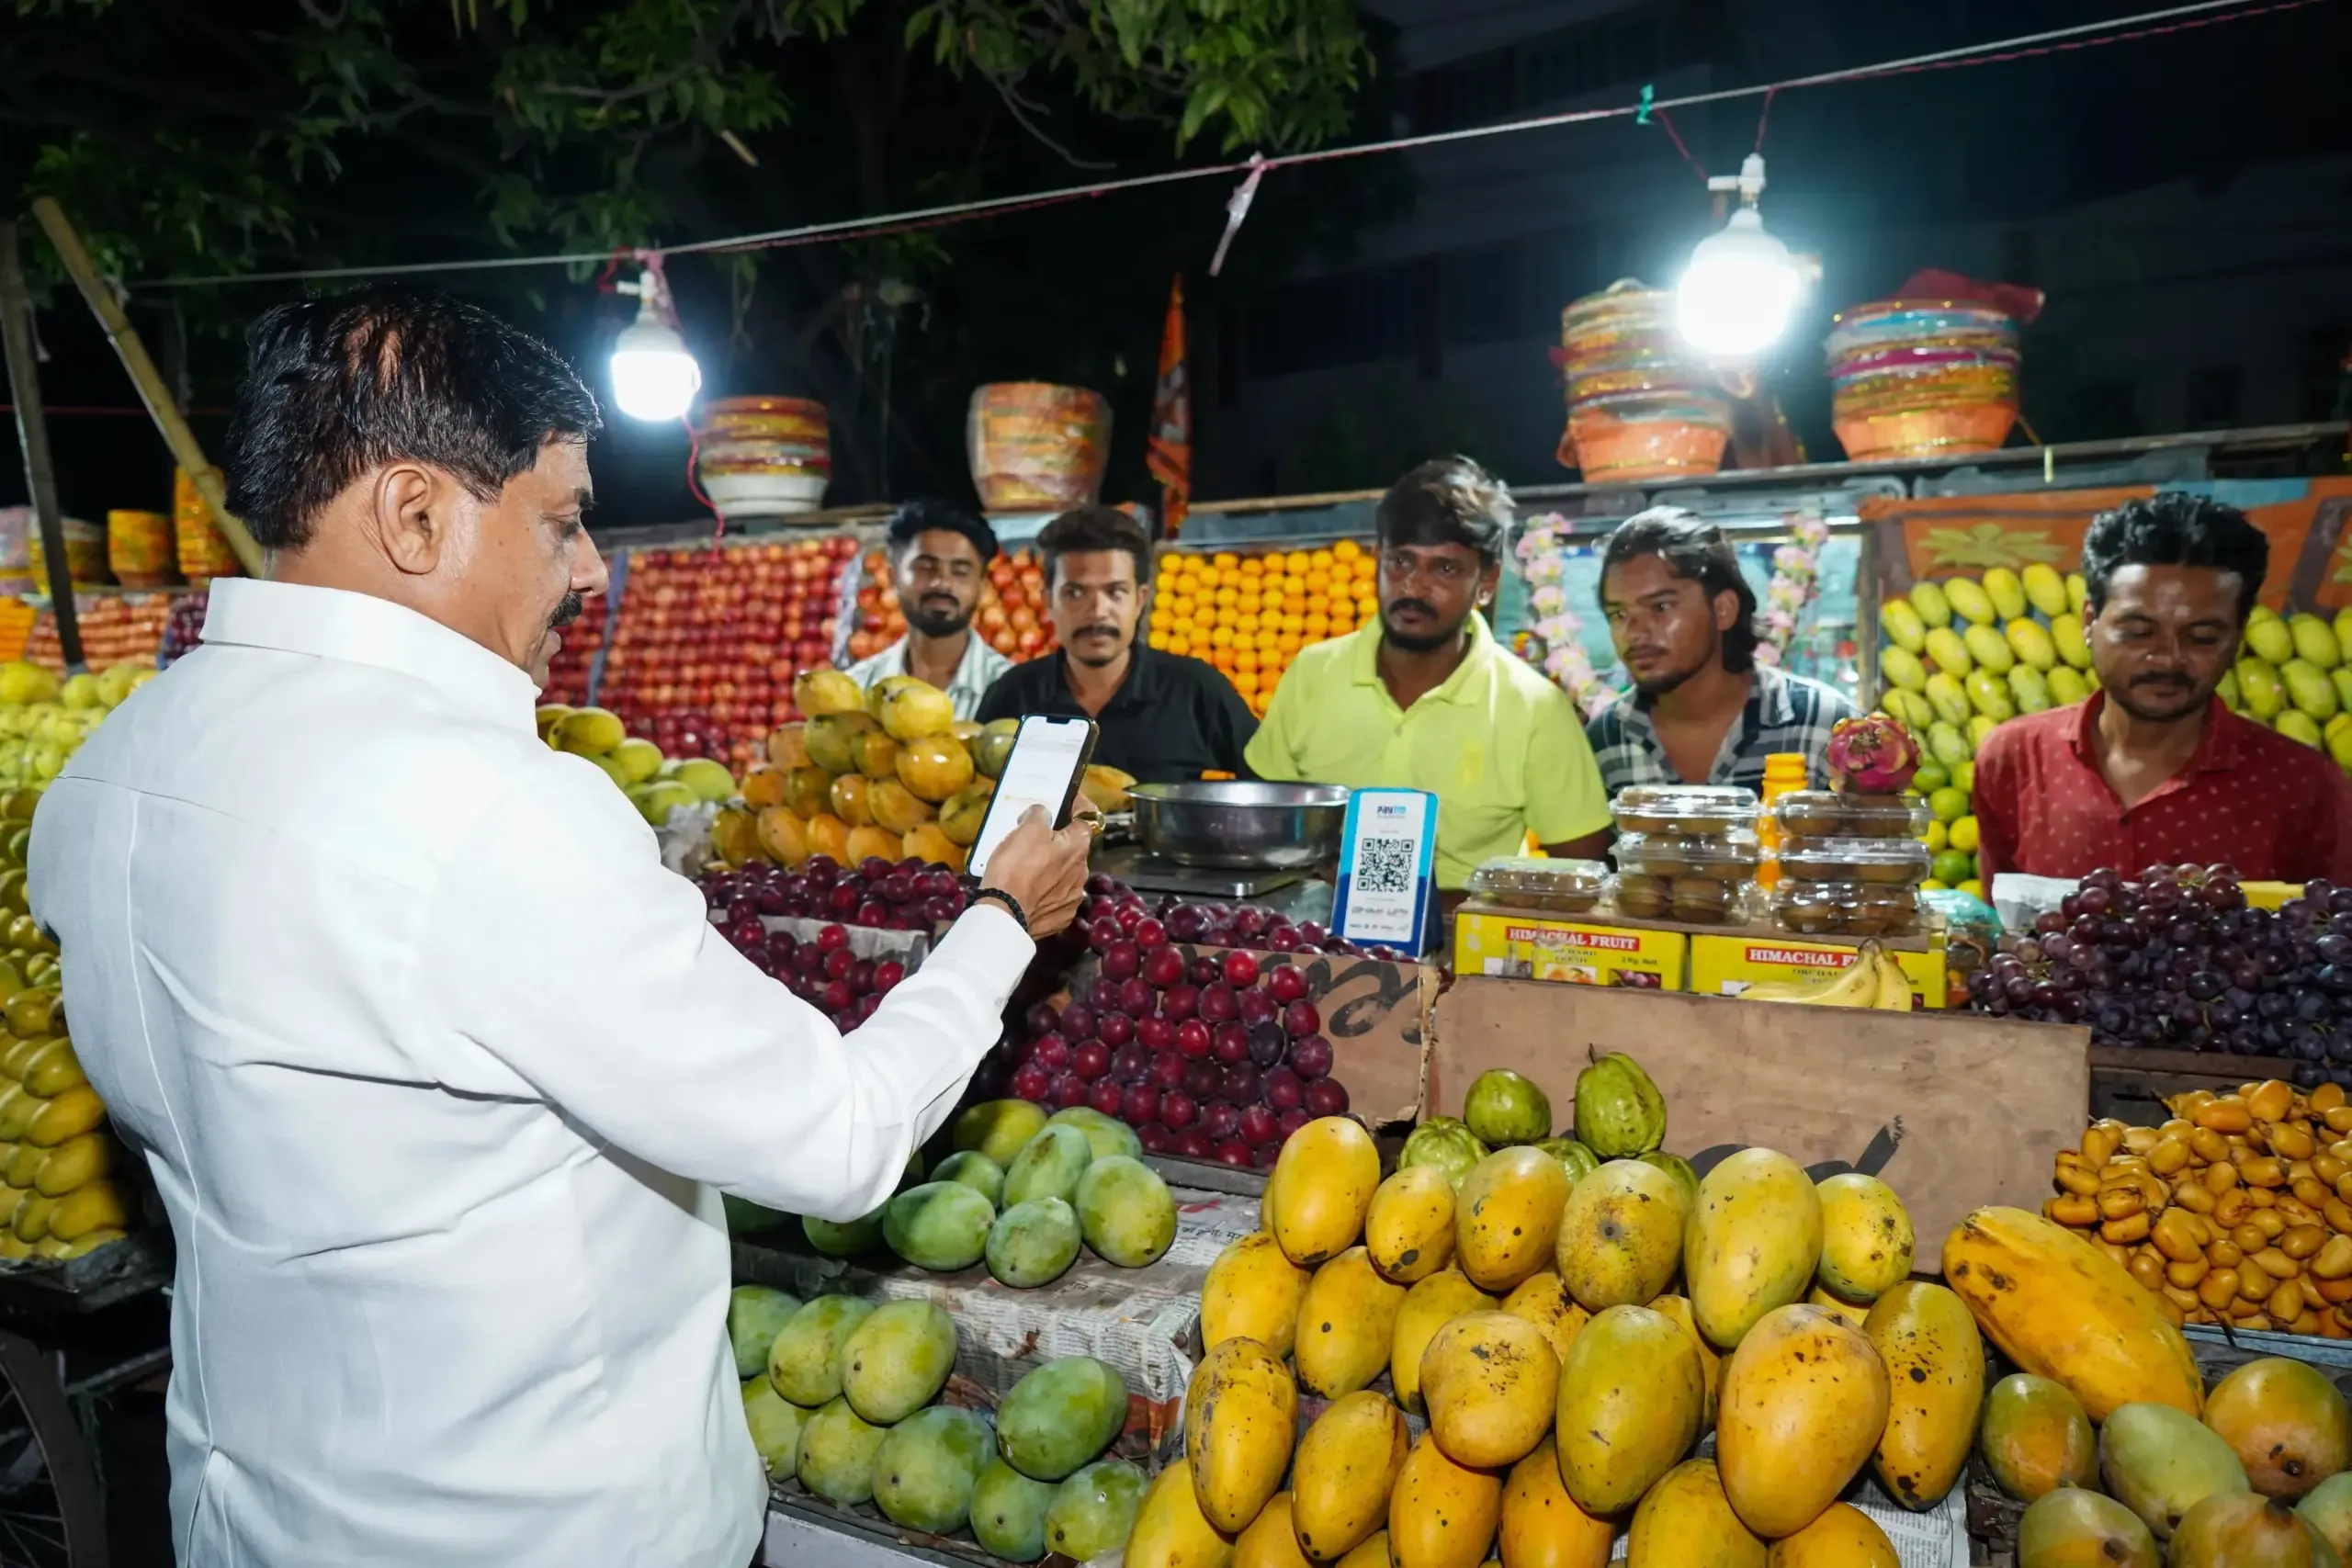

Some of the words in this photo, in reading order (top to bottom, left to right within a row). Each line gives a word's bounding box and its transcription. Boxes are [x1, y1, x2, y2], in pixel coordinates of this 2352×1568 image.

[1510, 928, 1587, 946] HIMACHAL
[1589, 935, 1636, 950] FRUIT
[1749, 948, 1838, 966] HIMACHAL
[1792, 968, 1838, 976] ORCHA
